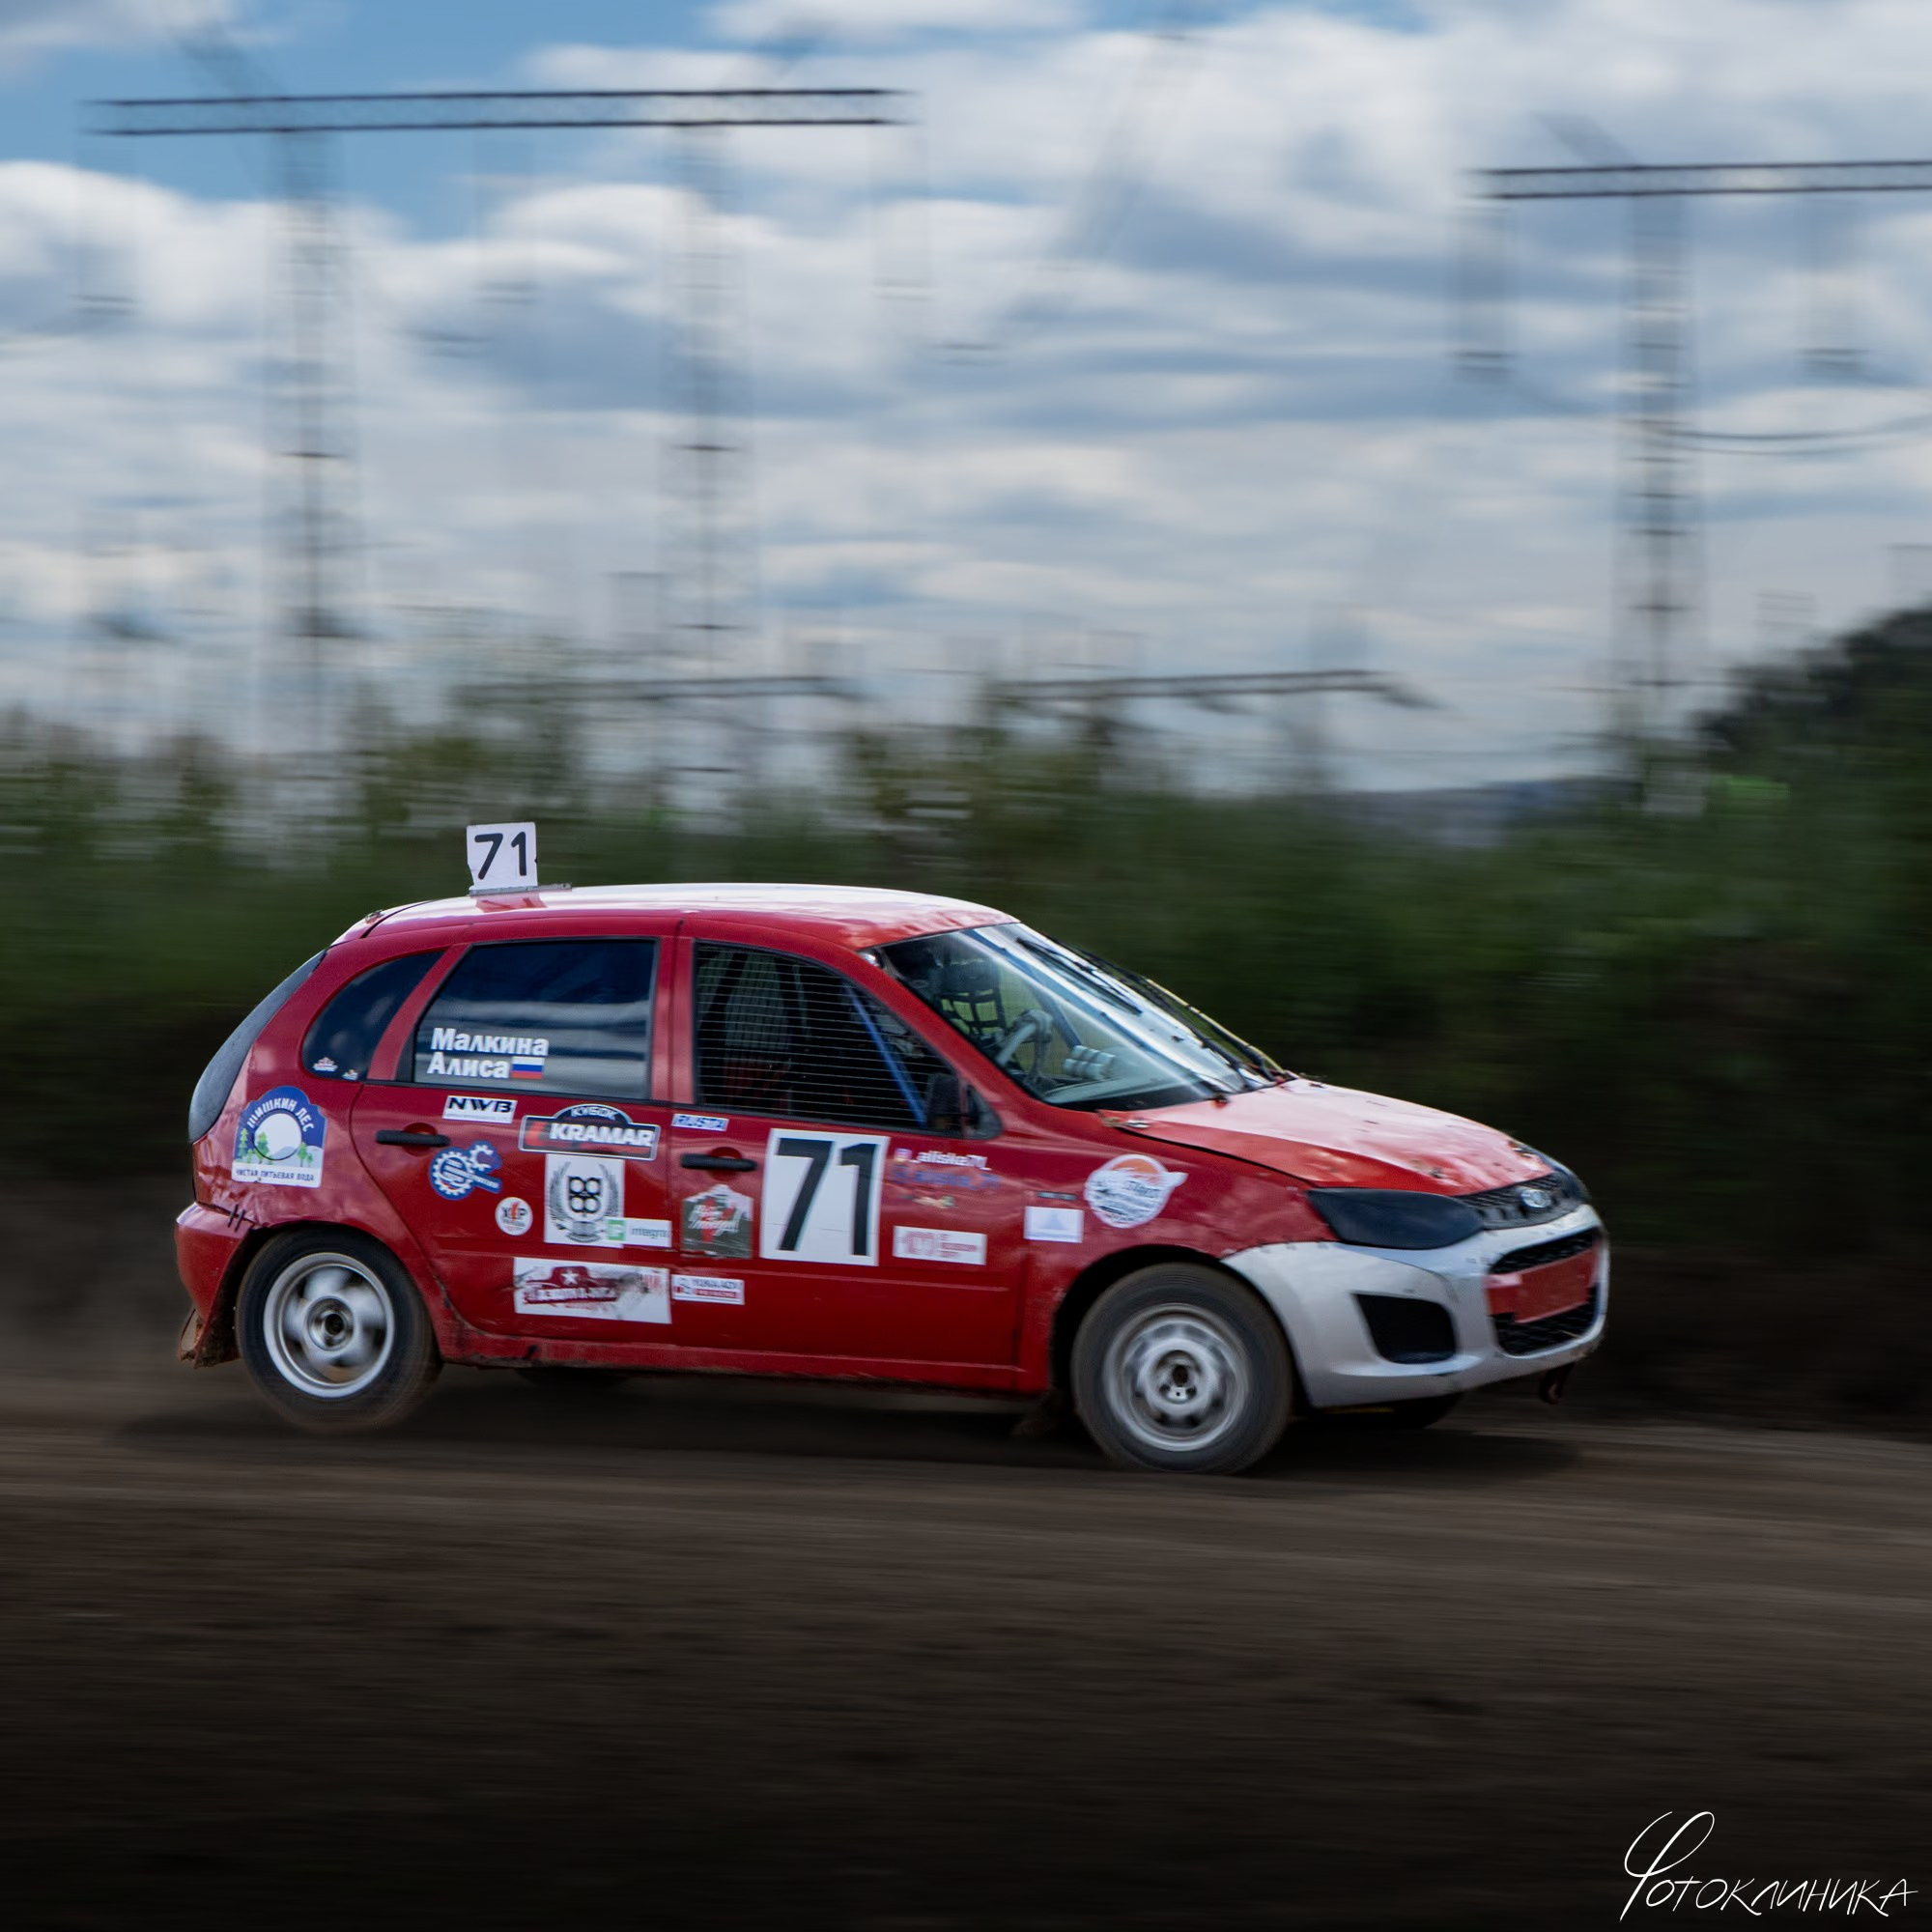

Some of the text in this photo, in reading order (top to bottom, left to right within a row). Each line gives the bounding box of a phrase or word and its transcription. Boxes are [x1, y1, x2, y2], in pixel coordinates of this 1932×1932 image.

[474, 831, 527, 880] 71
[430, 1027, 550, 1057] Малкина
[426, 1051, 510, 1079] Алиса
[246, 1097, 315, 1133] ШИШКИН ЛЕС
[447, 1096, 513, 1114] NWB
[549, 1122, 656, 1148] KRAMAR
[776, 1137, 880, 1257] 71
